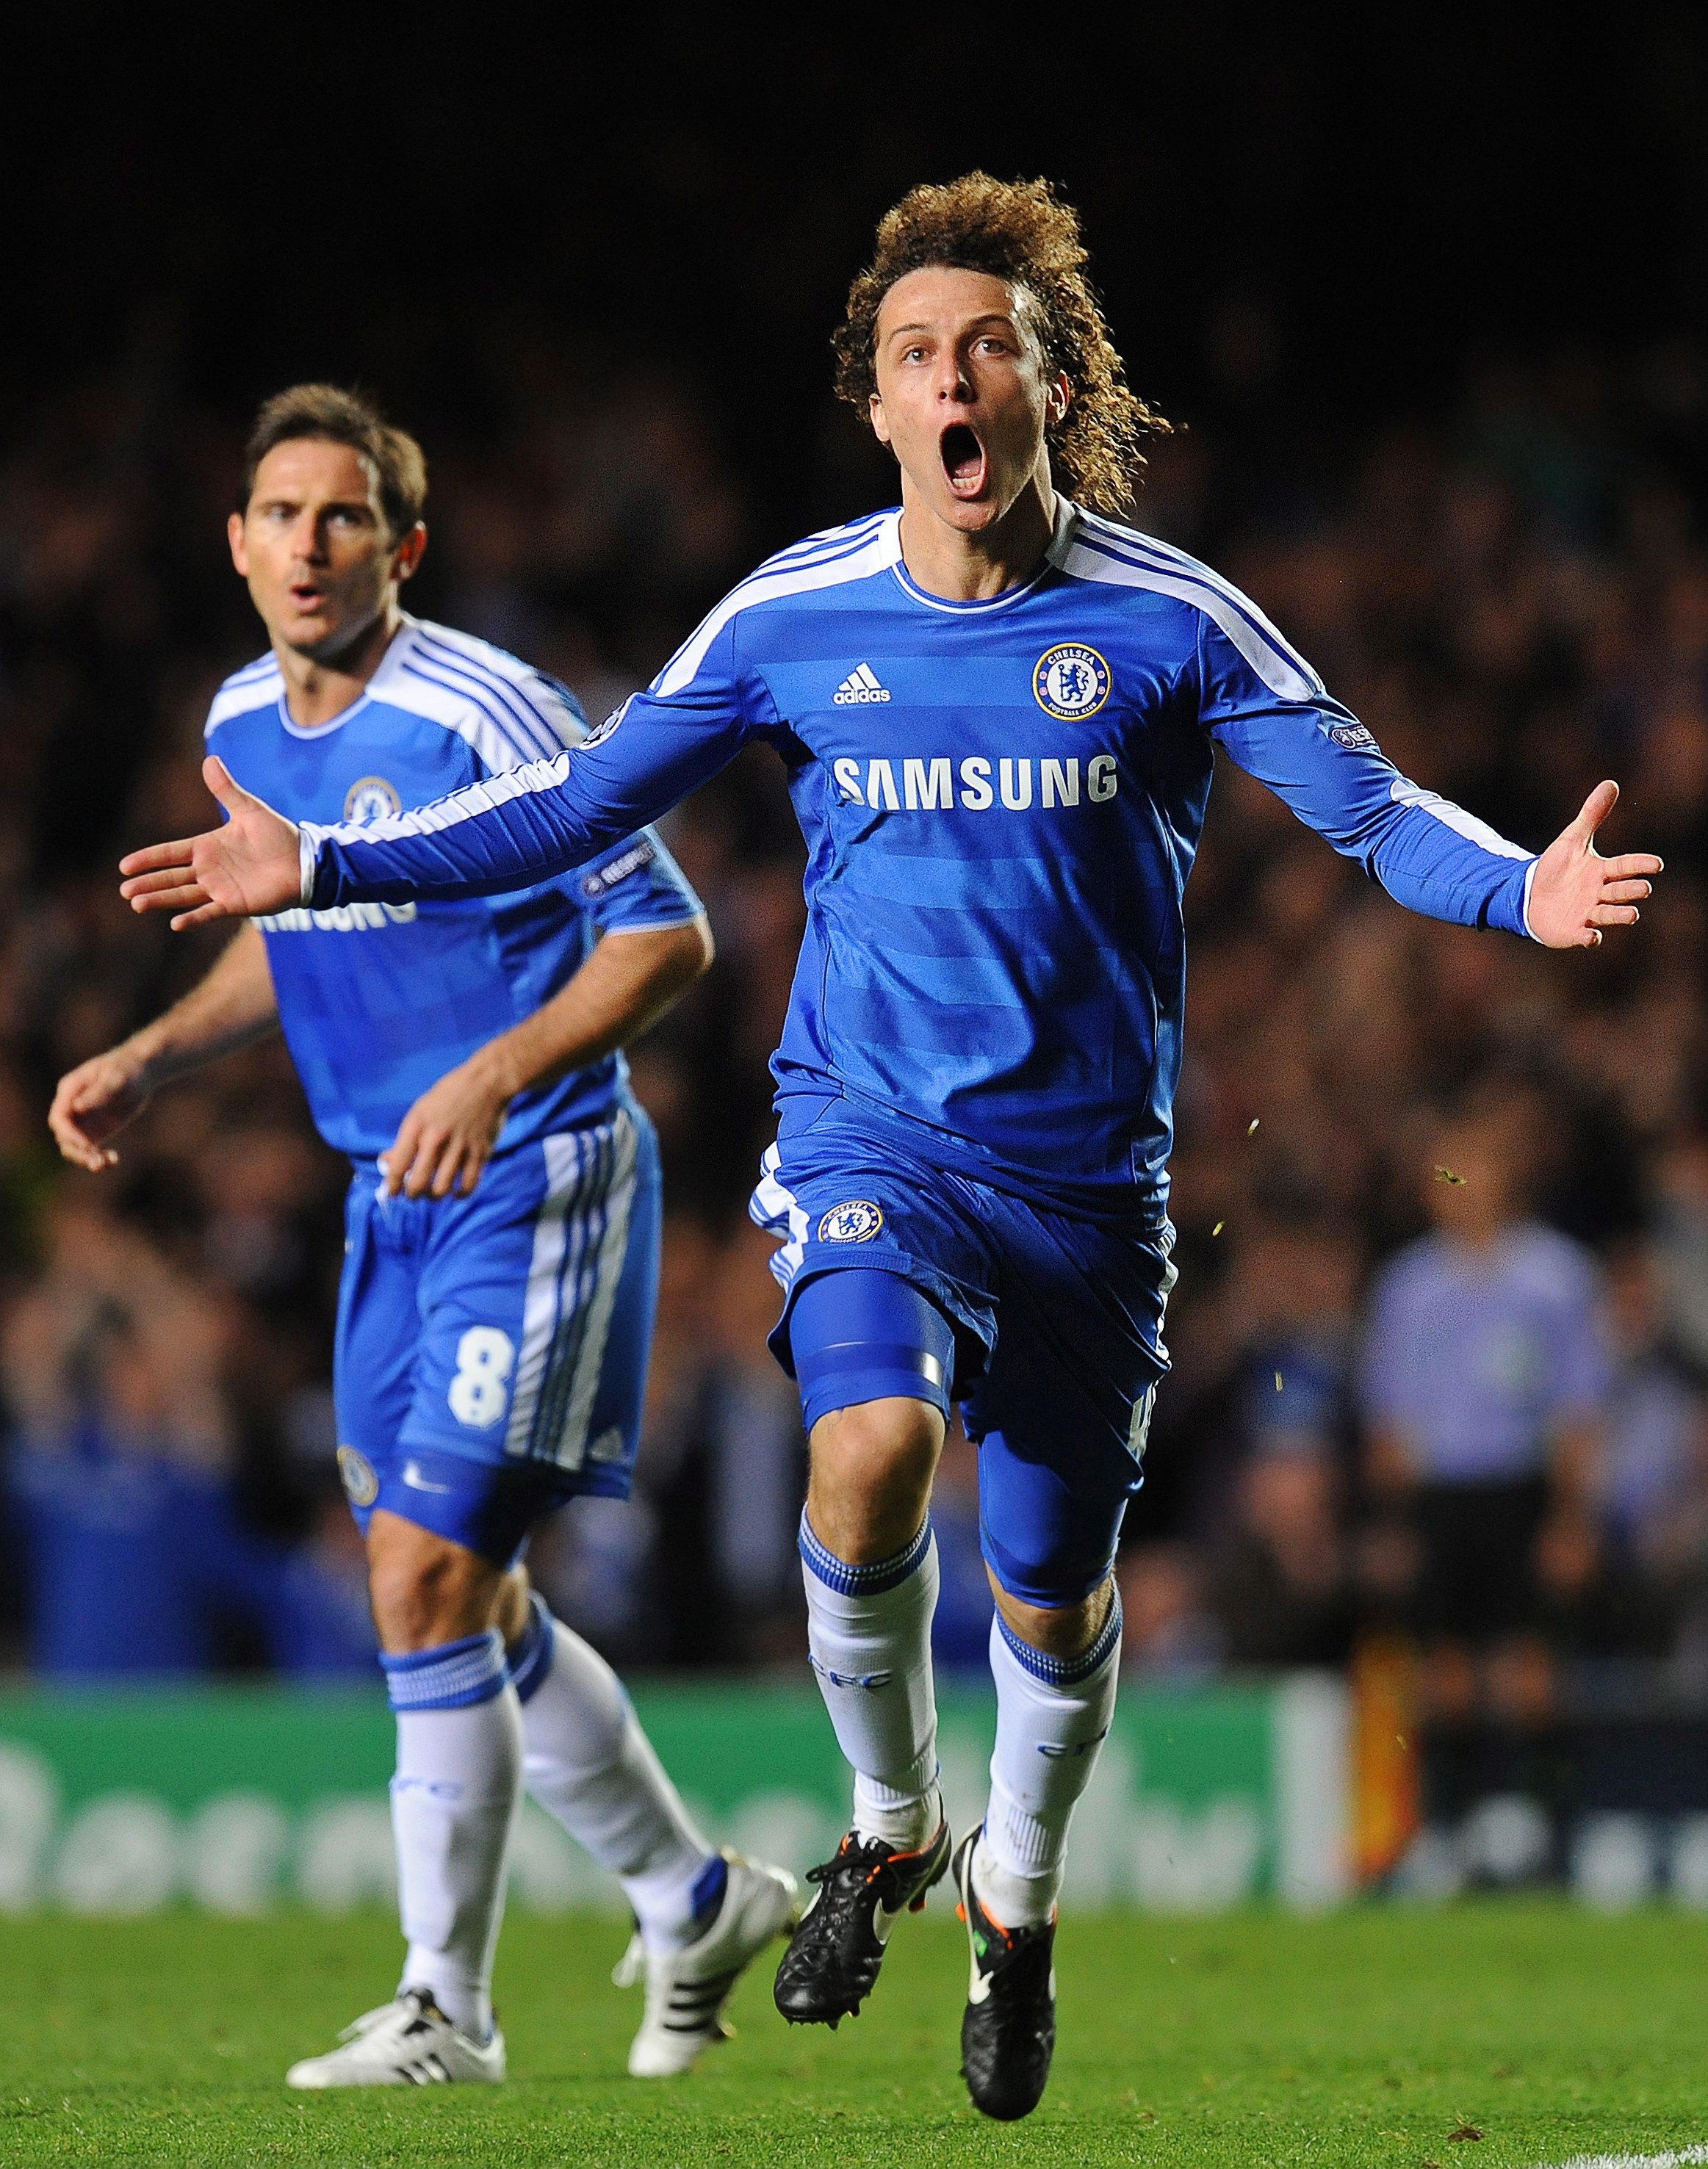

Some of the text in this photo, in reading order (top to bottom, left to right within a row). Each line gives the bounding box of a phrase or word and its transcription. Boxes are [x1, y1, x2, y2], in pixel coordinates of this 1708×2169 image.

[1047, 649, 1095, 665] CHELSEA
[833, 687, 892, 705] adidas
[832, 755, 1118, 811] SAMSUNG
[447, 1325, 514, 1429] 8
